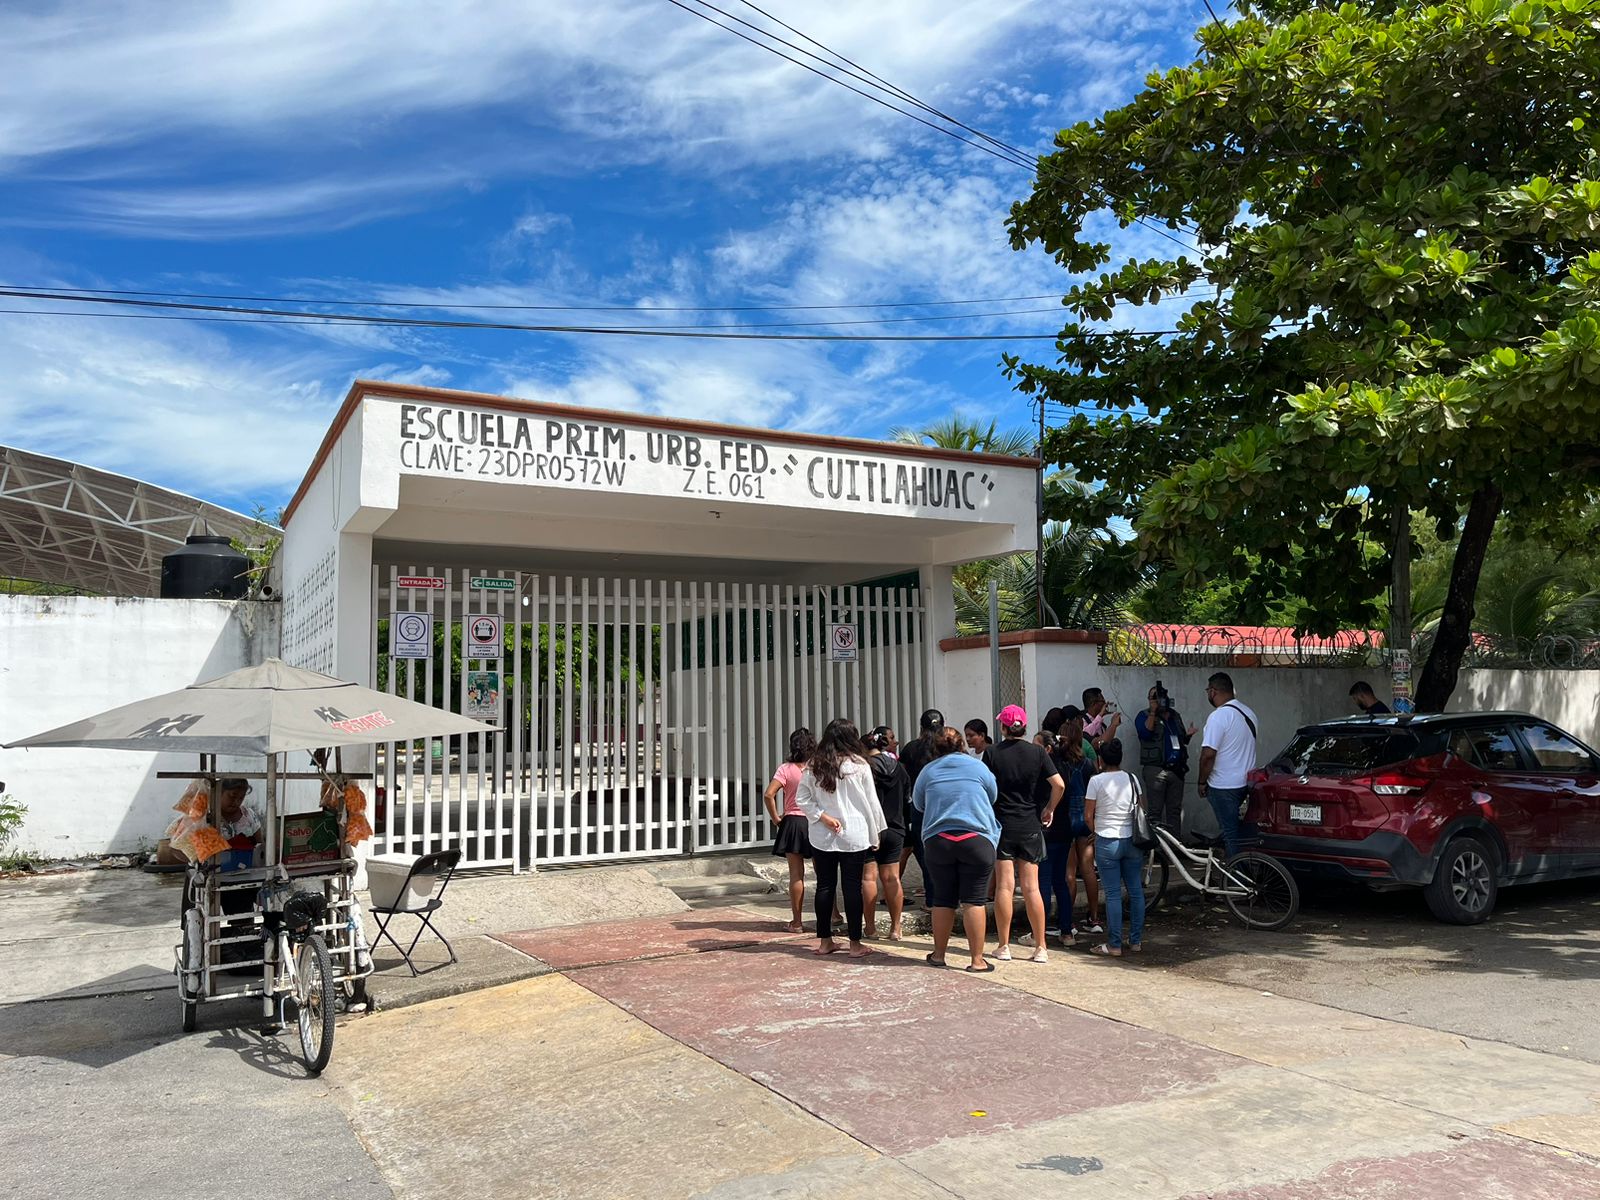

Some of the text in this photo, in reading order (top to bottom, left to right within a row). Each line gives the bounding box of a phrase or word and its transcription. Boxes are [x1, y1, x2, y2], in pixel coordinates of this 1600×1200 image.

[400, 404, 533, 451] ESCUELA
[545, 420, 636, 461] PRIM.
[646, 432, 712, 468] URB.
[719, 440, 776, 475] FED.
[399, 440, 472, 472] CLAVE:
[728, 472, 765, 499] 061
[399, 578, 431, 587] ENTRADA
[485, 580, 513, 588] SALIDA
[331, 711, 394, 733] TECATE
